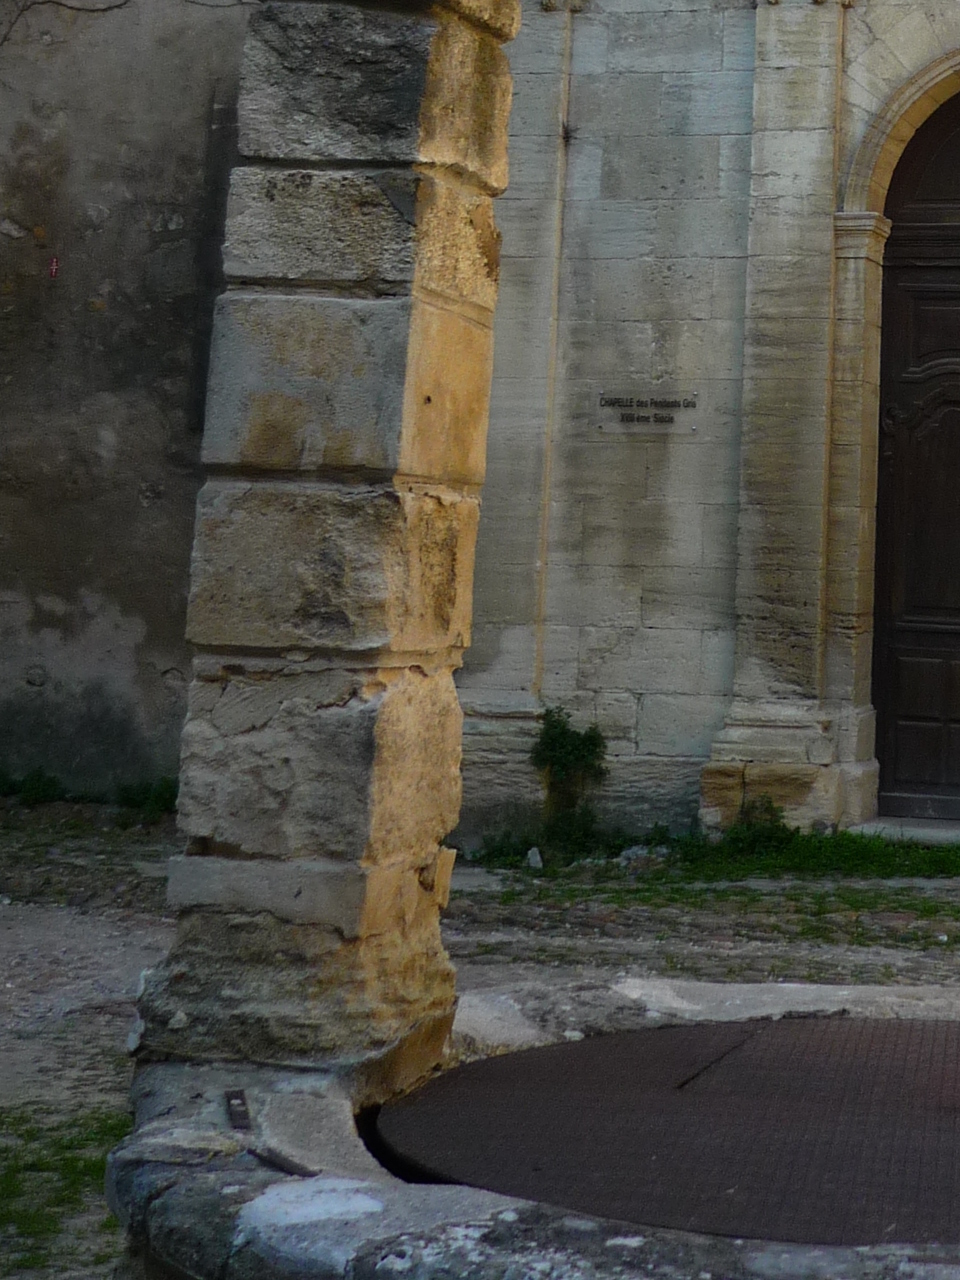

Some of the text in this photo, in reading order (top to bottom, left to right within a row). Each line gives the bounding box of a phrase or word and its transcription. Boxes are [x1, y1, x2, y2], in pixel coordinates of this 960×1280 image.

[600, 397, 634, 407] CHAPELLE
[636, 398, 648, 407] des
[683, 399, 696, 408] Gris
